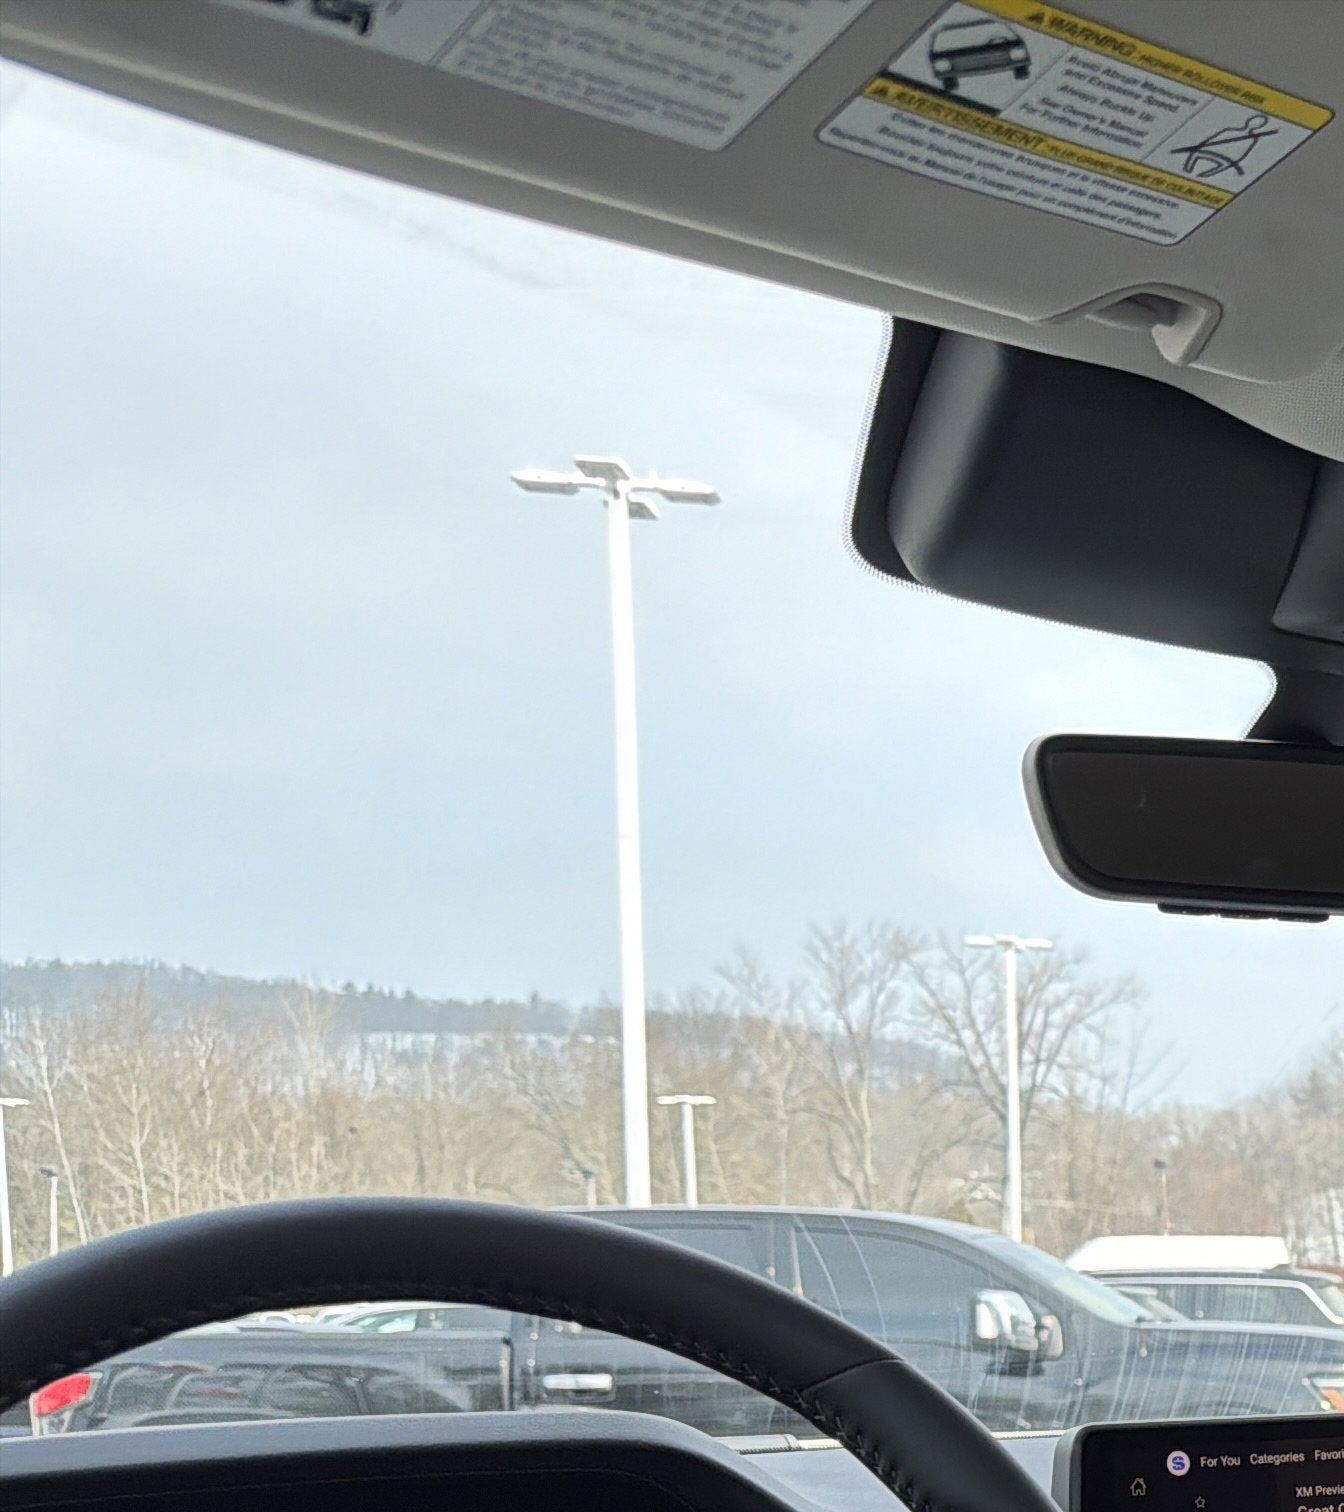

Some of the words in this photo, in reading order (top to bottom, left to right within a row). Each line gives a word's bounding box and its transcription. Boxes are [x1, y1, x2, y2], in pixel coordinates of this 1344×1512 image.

[1048, 16, 1137, 57] WARNING
[1200, 1455, 1219, 1467] For
[1220, 1454, 1241, 1466] You
[1249, 1451, 1305, 1466] Categories
[1295, 1486, 1313, 1498] XM
